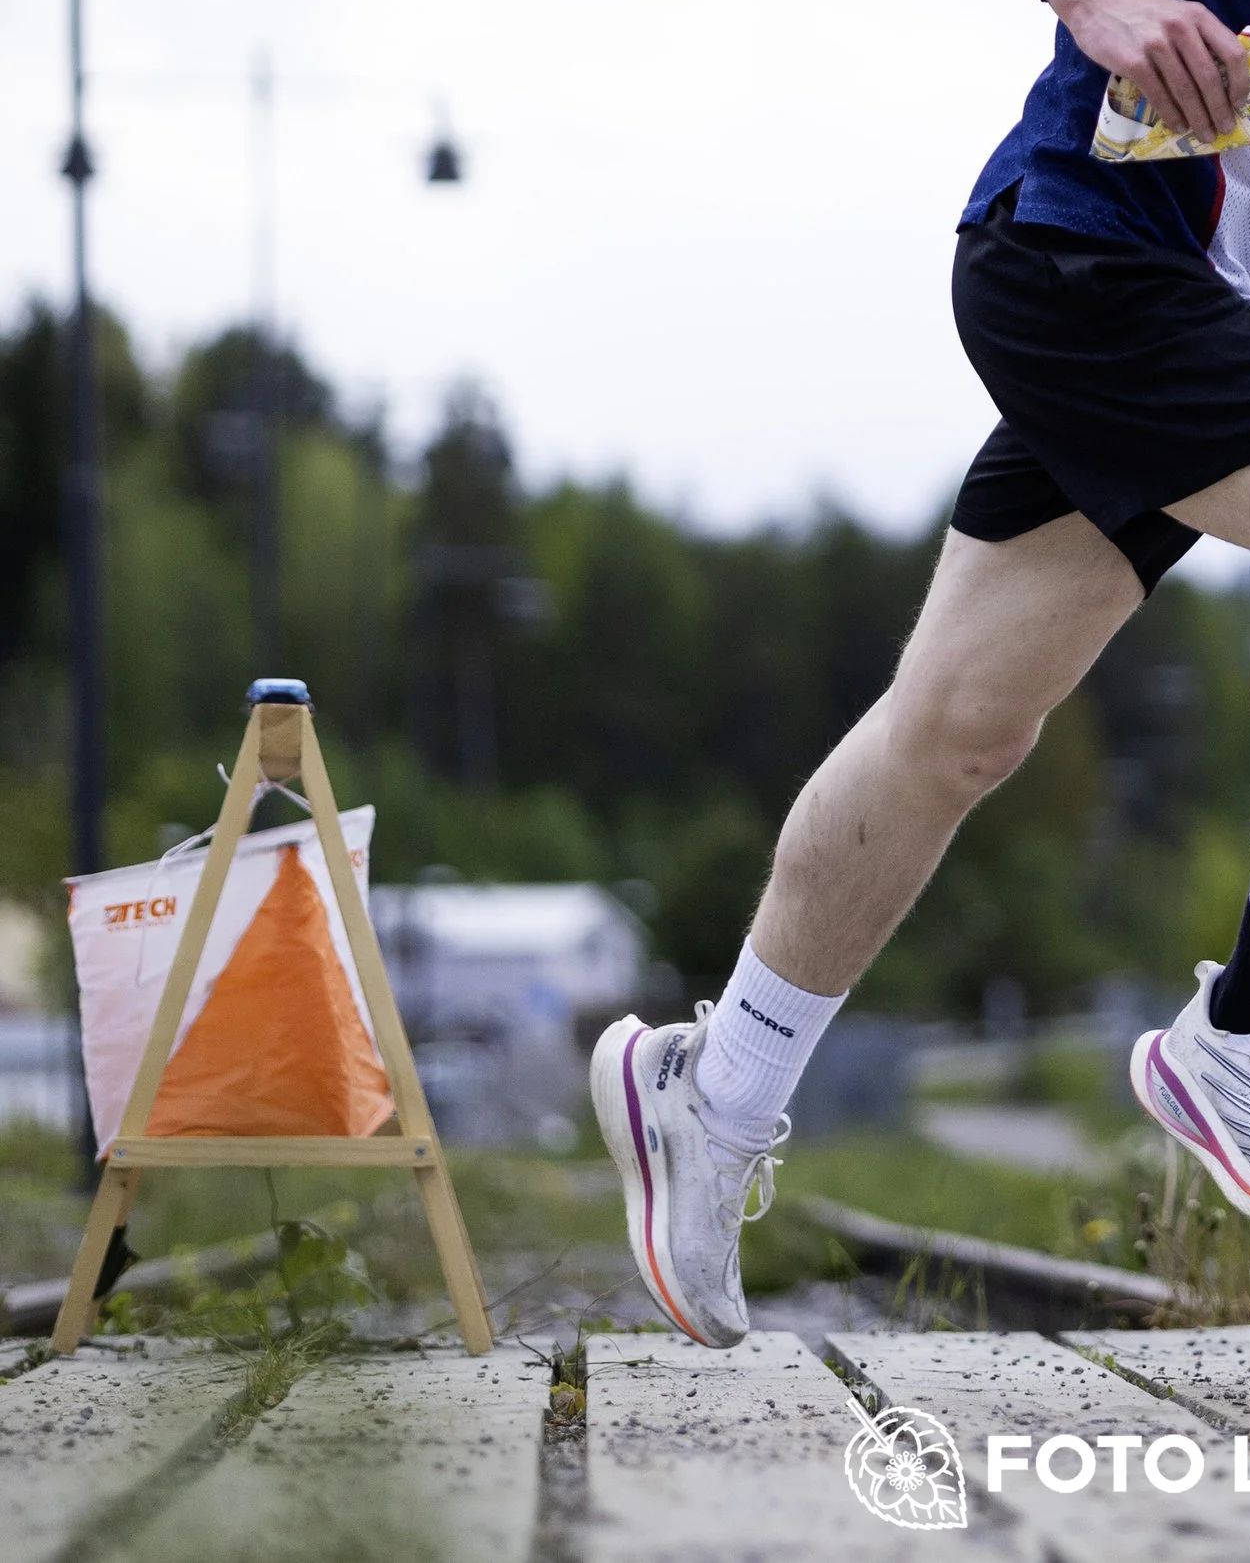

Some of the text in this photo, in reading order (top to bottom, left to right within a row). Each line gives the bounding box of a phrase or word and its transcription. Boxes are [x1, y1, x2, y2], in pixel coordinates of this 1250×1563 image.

[740, 998, 796, 1038] BORG
[656, 1034, 686, 1090] balance
[673, 1049, 688, 1079] new
